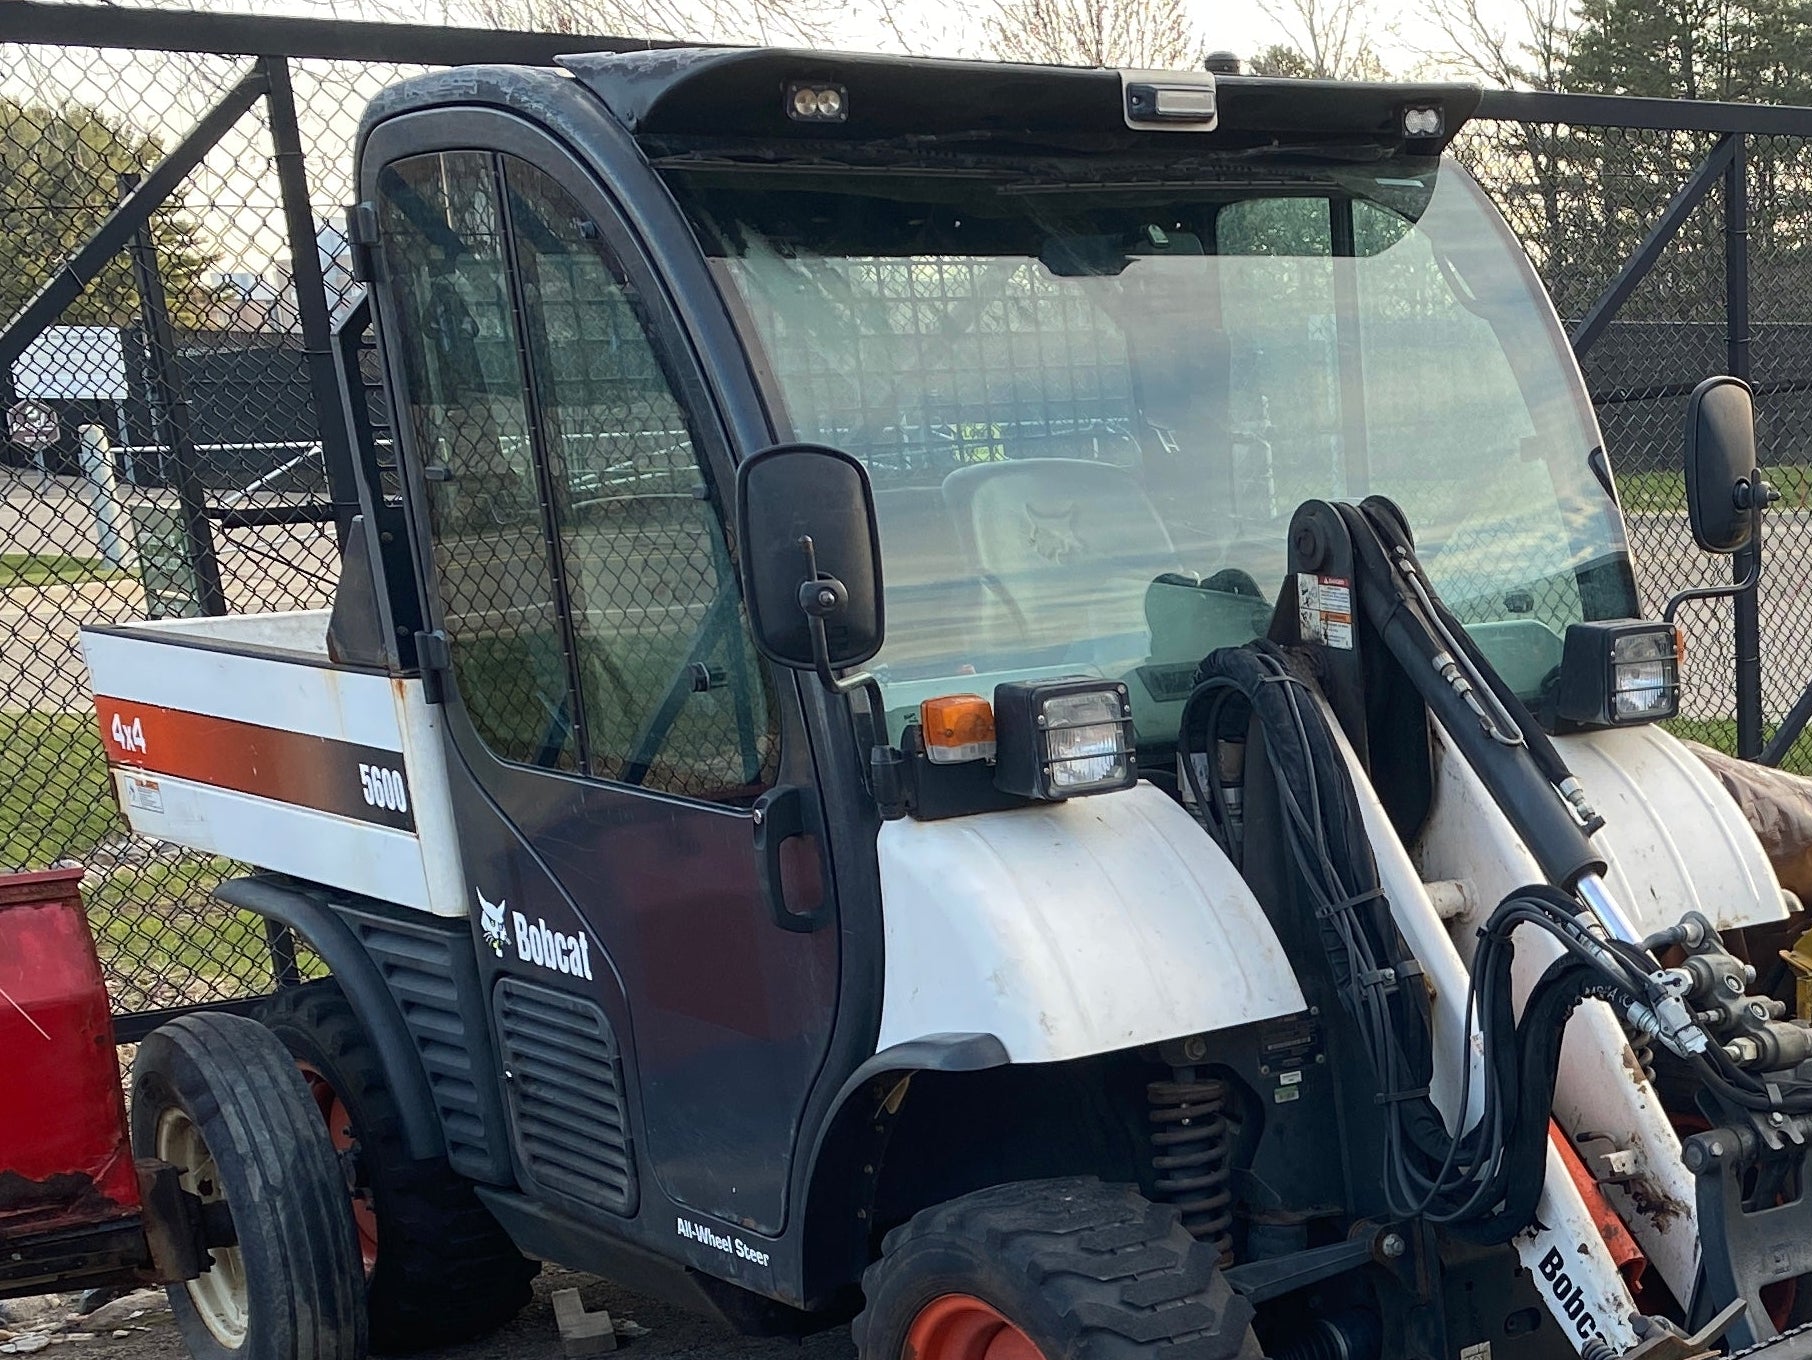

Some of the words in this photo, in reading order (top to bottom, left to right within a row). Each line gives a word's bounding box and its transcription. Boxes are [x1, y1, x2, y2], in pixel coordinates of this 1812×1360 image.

[111, 712, 147, 754] 4x4
[358, 762, 408, 814] 5600
[511, 910, 593, 981] Bobcat
[677, 1217, 734, 1254] All-Wheel
[734, 1238, 770, 1267] Steer
[1538, 1244, 1609, 1346] Bobc
